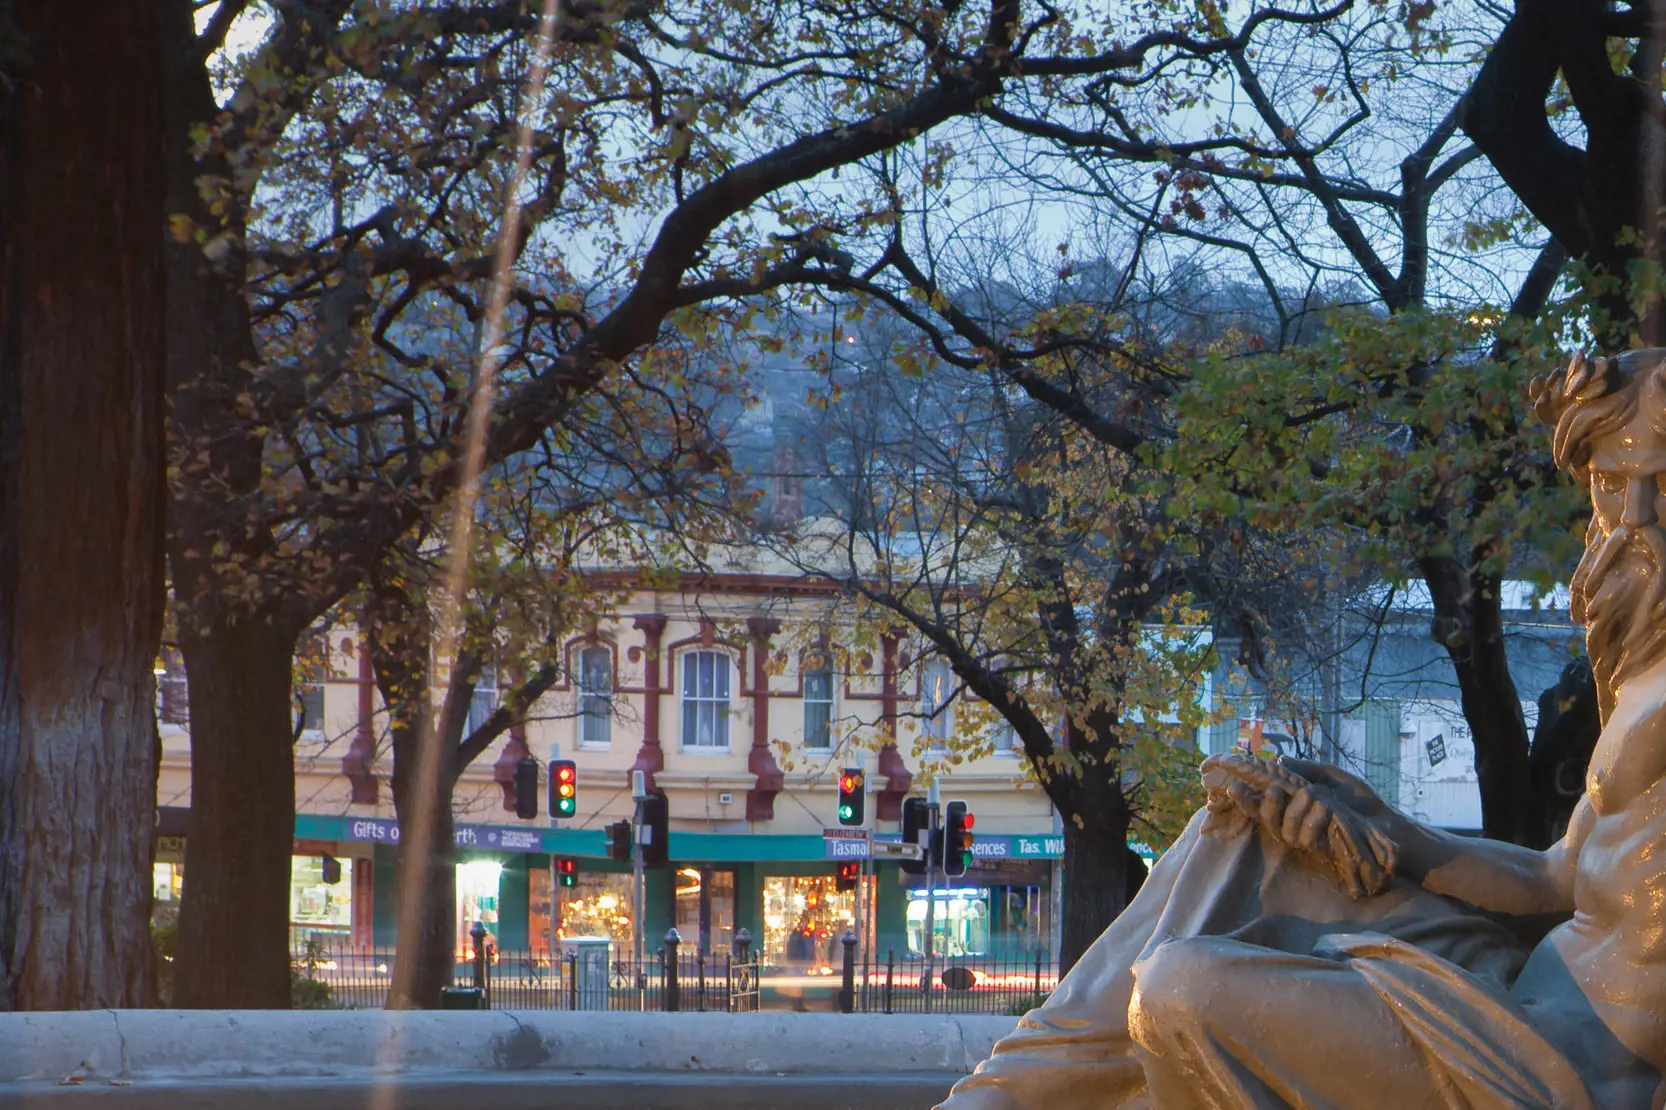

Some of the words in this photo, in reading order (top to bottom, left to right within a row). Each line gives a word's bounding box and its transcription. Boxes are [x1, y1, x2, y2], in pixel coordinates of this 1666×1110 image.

[353, 821, 385, 839] Gifts
[390, 827, 399, 840] o
[453, 828, 477, 845] rth
[831, 839, 869, 857] Tasma
[969, 843, 1006, 856] sences
